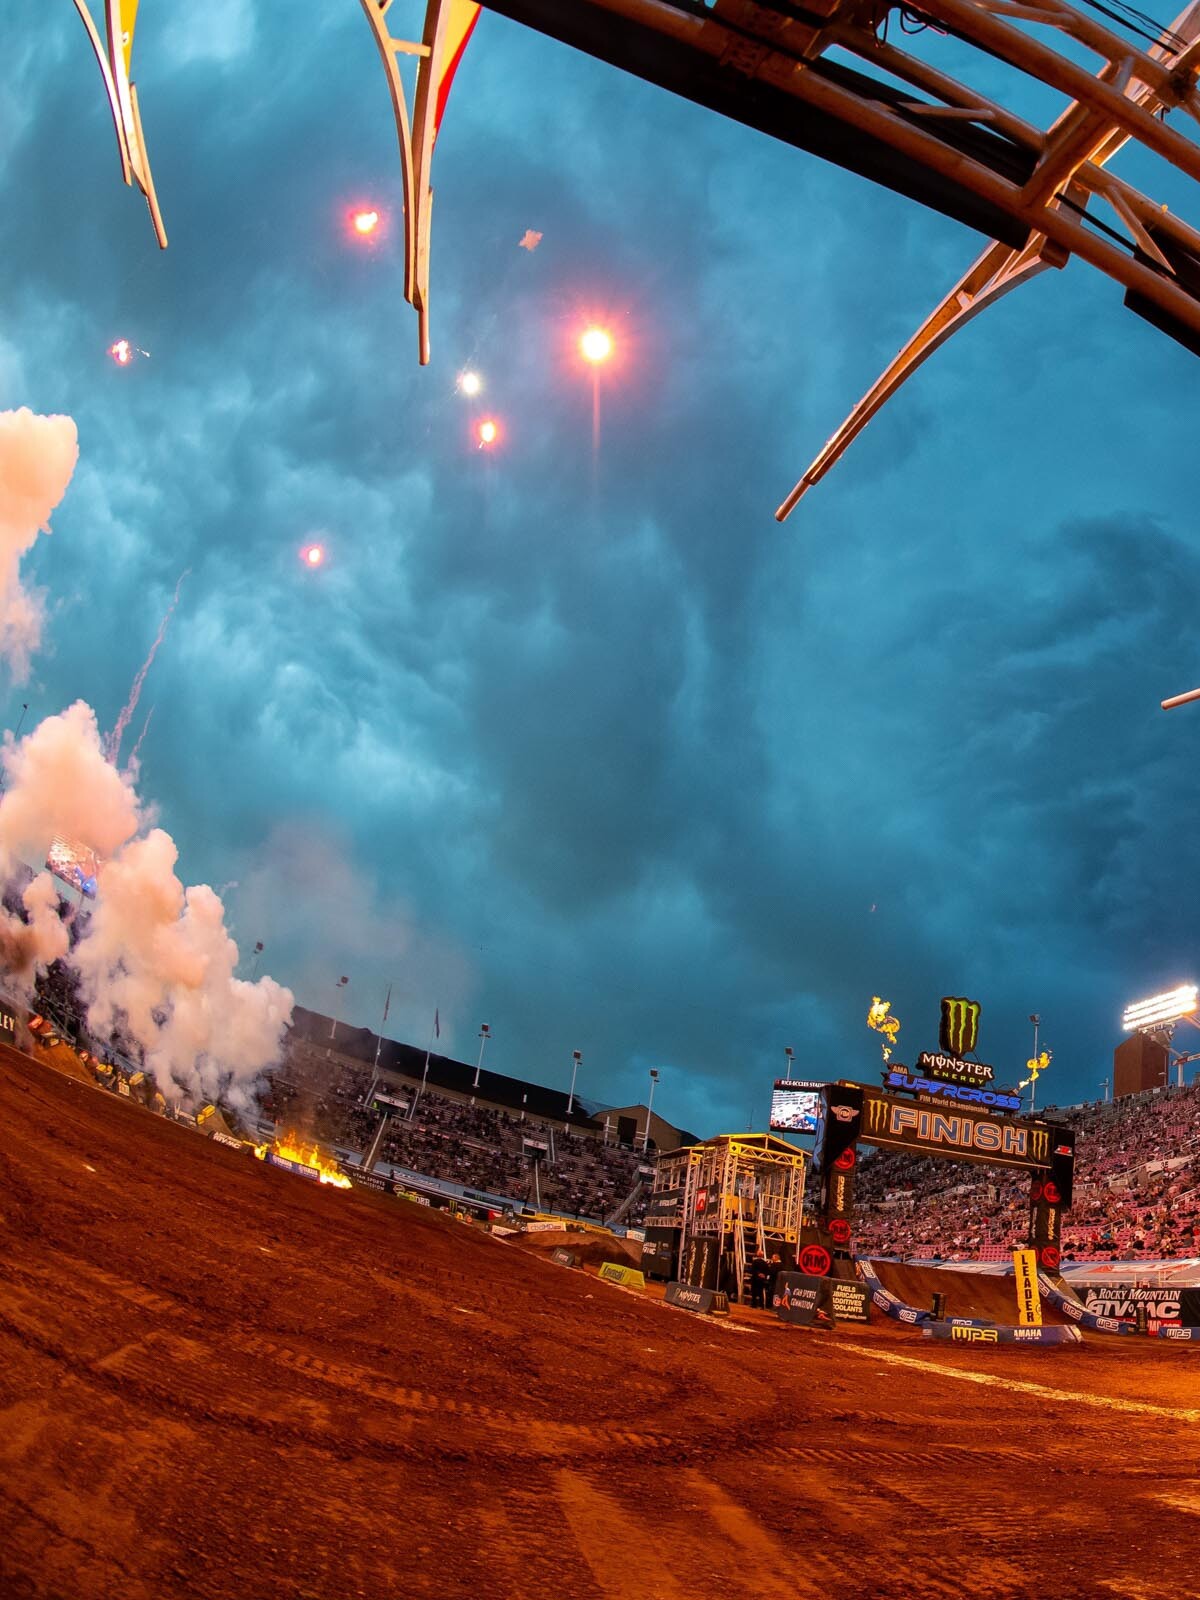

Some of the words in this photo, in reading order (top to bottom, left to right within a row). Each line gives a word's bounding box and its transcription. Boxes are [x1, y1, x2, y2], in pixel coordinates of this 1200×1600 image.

[891, 1065, 908, 1076] AMA
[922, 1053, 993, 1079] MONSTER
[933, 1070, 985, 1085] ENERGY
[890, 1105, 1028, 1156] FINISH
[1020, 1254, 1035, 1323] LEADER
[1098, 1288, 1128, 1300] ROCKY
[1128, 1288, 1182, 1301] MOUNTAIN
[1095, 1317, 1119, 1332] WPS
[952, 1326, 998, 1343] WPS
[1166, 1328, 1192, 1340] WPS
